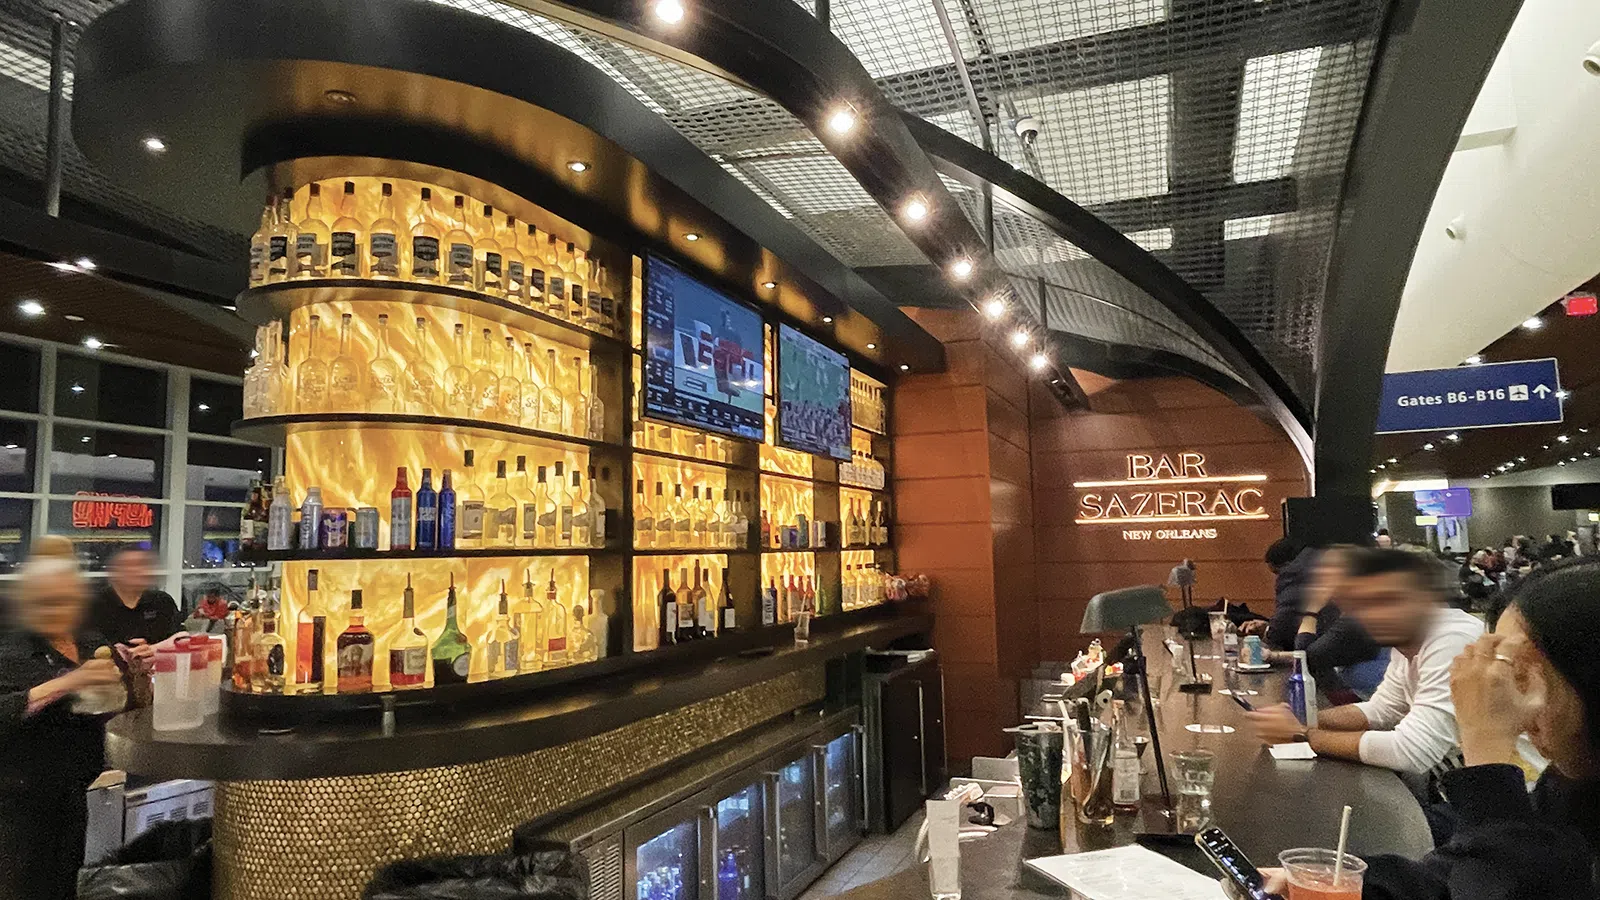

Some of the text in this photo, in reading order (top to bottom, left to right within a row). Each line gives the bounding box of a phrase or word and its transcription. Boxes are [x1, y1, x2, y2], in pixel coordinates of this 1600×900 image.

[1397, 388, 1505, 407] Gates B6-B16
[1126, 452, 1208, 481] BAR
[1079, 488, 1266, 520] SAZERAC
[1122, 528, 1218, 540] NEW ORLEANS
